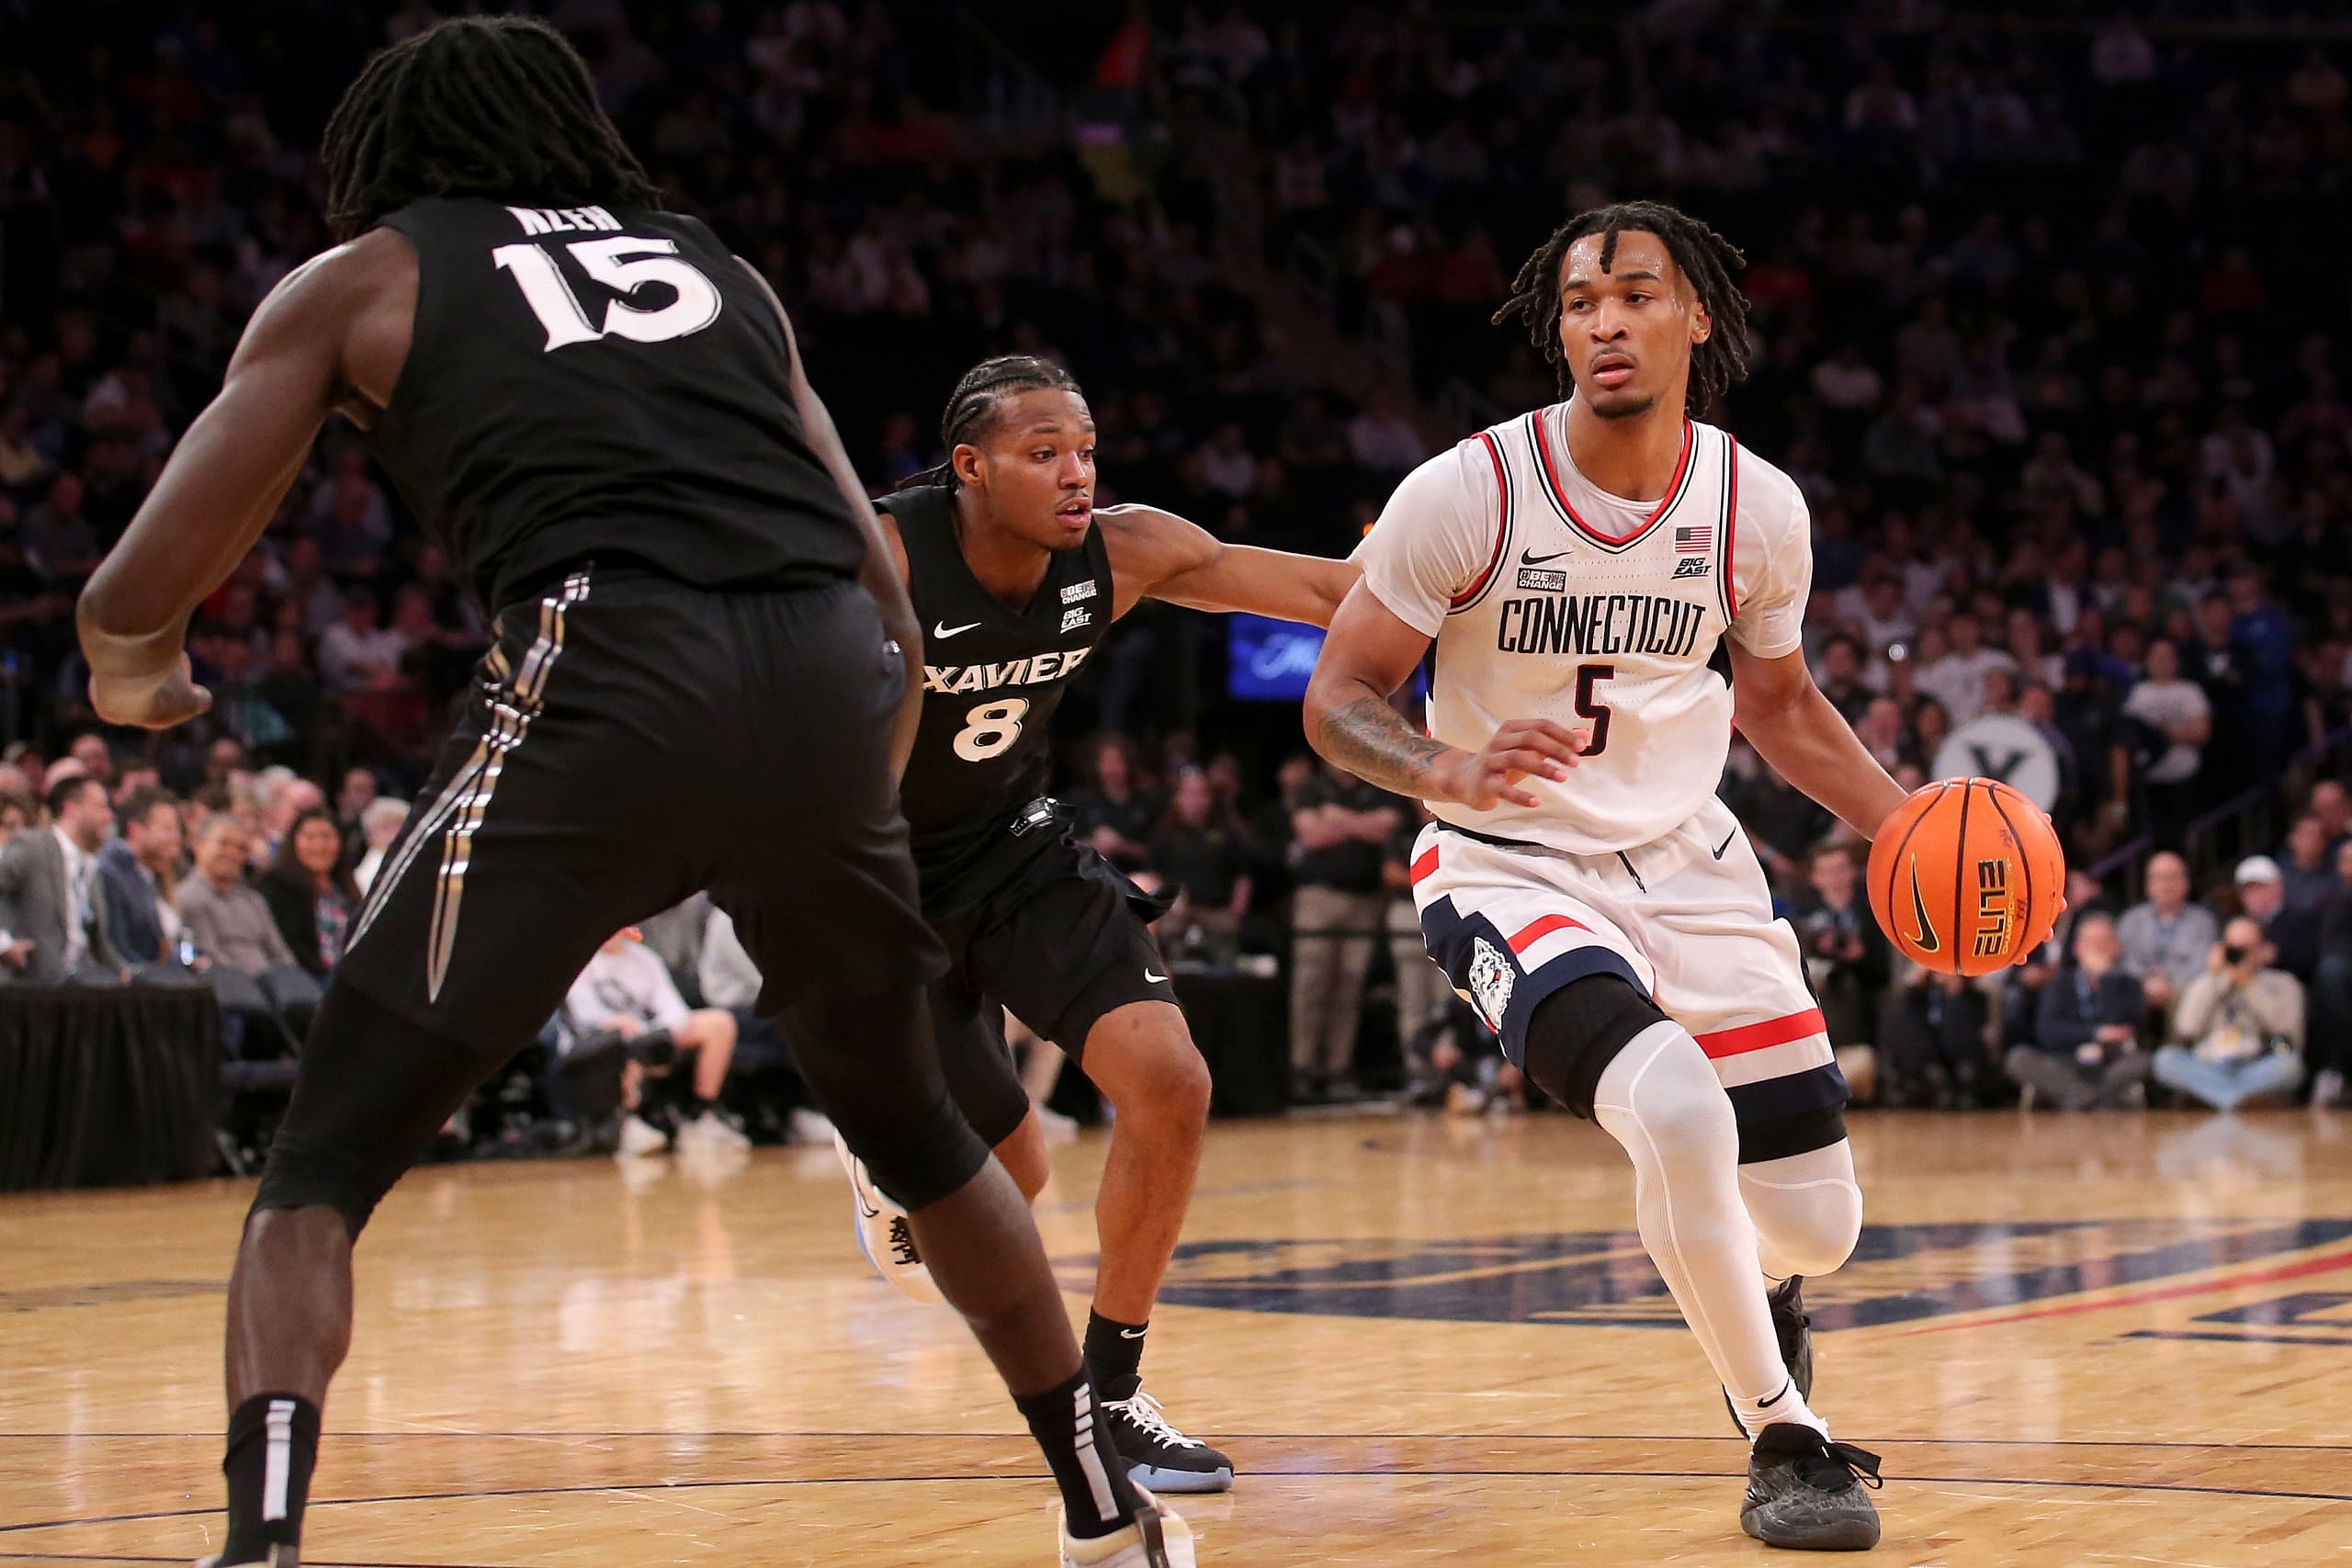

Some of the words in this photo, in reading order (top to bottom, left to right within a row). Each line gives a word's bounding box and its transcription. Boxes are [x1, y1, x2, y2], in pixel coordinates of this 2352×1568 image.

[492, 235, 723, 353] 15
[1679, 557, 1706, 567] BIG
[1528, 570, 1551, 582] BE
[1673, 565, 1713, 575] EAST
[1067, 582, 1084, 596] BE
[1519, 580, 1564, 591] CHANGE
[1062, 588, 1097, 604] CHANGE
[1060, 613, 1092, 628] EAST
[1063, 606, 1084, 620] BIG
[1498, 594, 1706, 657] CONNECTICUT
[922, 646, 1092, 695] XAVIER
[1574, 663, 1615, 757] 5
[953, 696, 1030, 763] 8
[1973, 857, 2007, 957] ELITE
